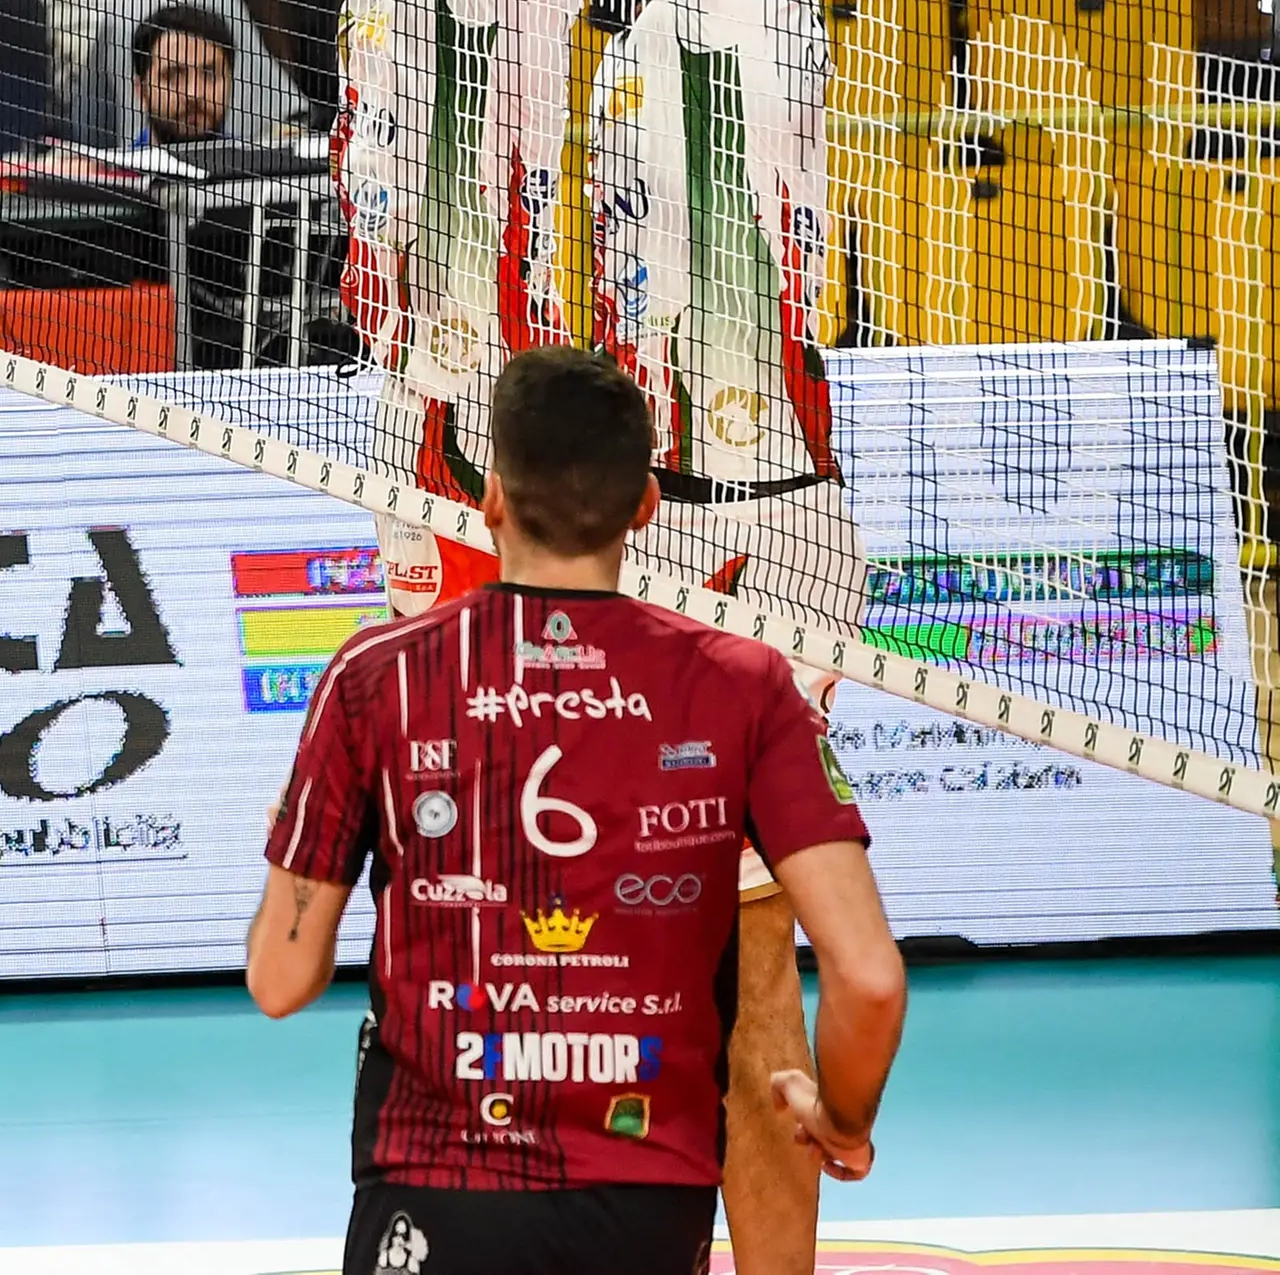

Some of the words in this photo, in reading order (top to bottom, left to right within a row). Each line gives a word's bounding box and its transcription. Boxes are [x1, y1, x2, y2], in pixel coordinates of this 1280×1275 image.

[465, 676, 655, 728] #presta
[519, 744, 599, 858] 6
[638, 796, 729, 838] FOTI
[614, 873, 703, 907] eco
[491, 953, 557, 969] CORONA
[559, 953, 630, 969] PETROLI
[546, 991, 637, 1015] service
